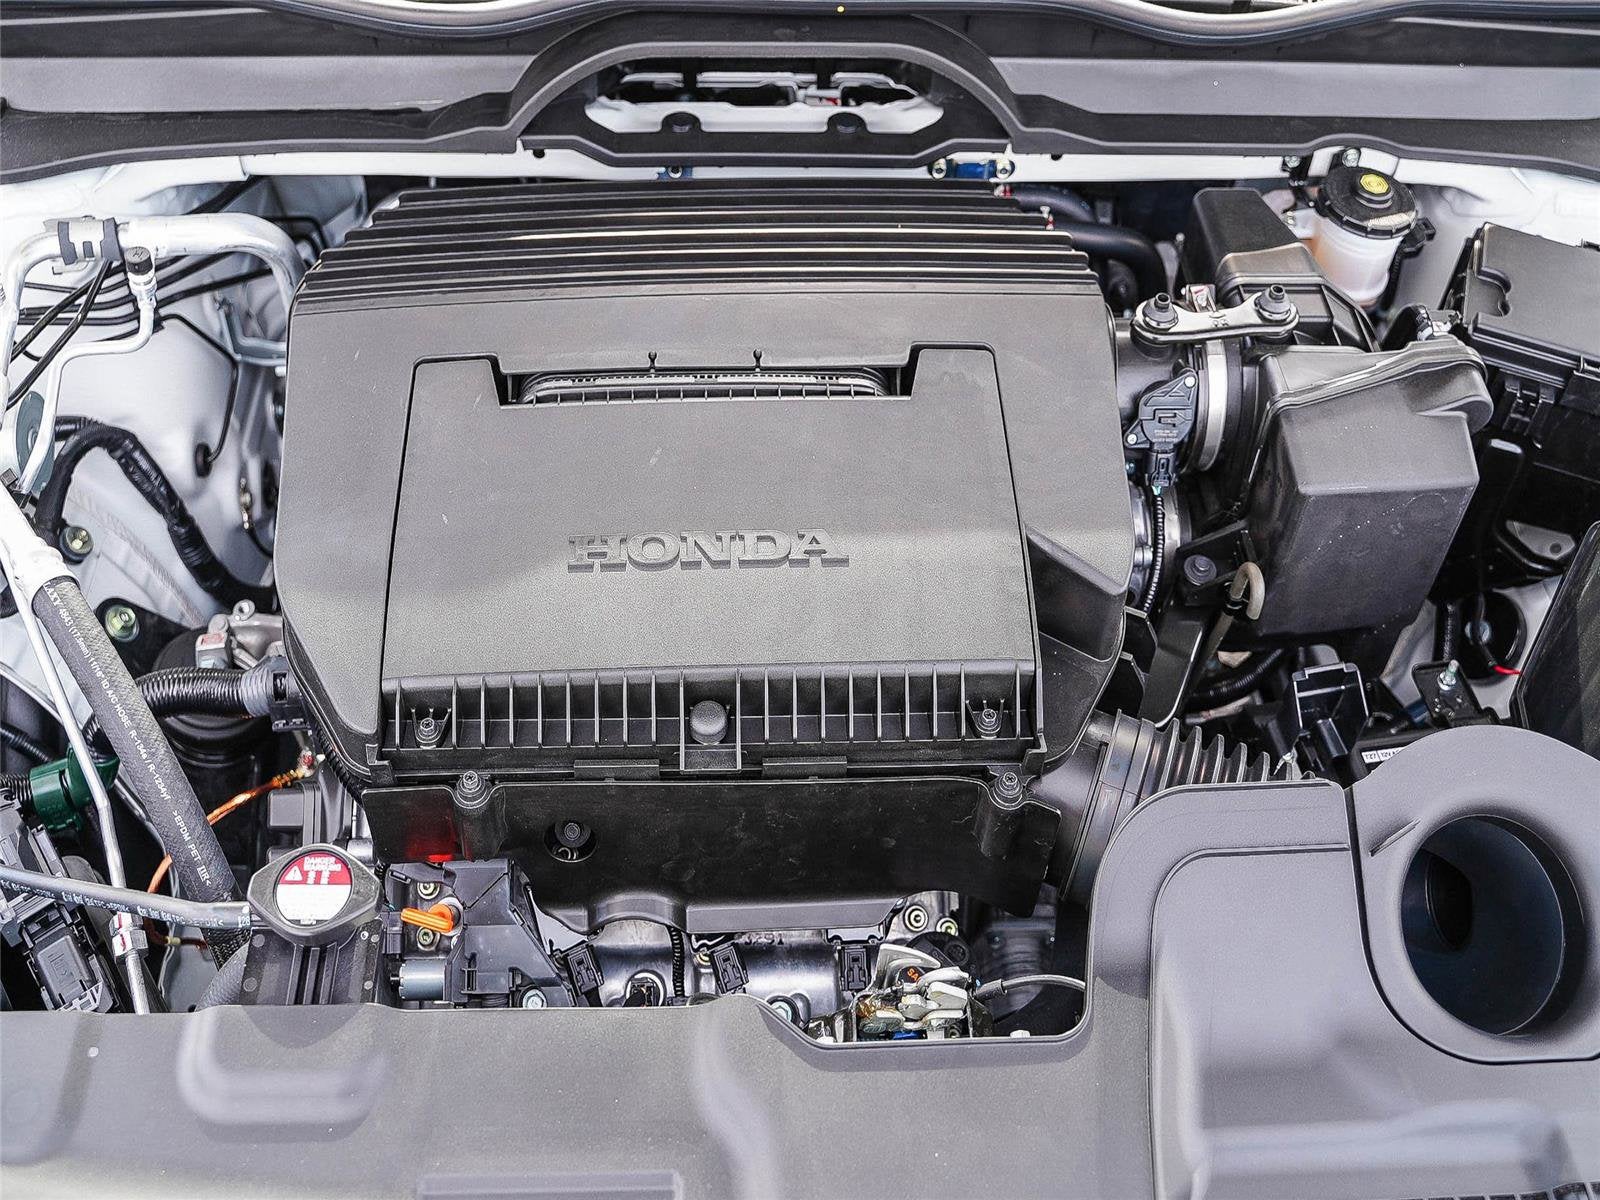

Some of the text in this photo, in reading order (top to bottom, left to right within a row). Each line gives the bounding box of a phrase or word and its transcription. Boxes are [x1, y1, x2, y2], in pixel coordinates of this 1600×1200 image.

[567, 528, 850, 573] HONDA
[113, 703, 132, 728] HOSE
[187, 843, 201, 861] PET
